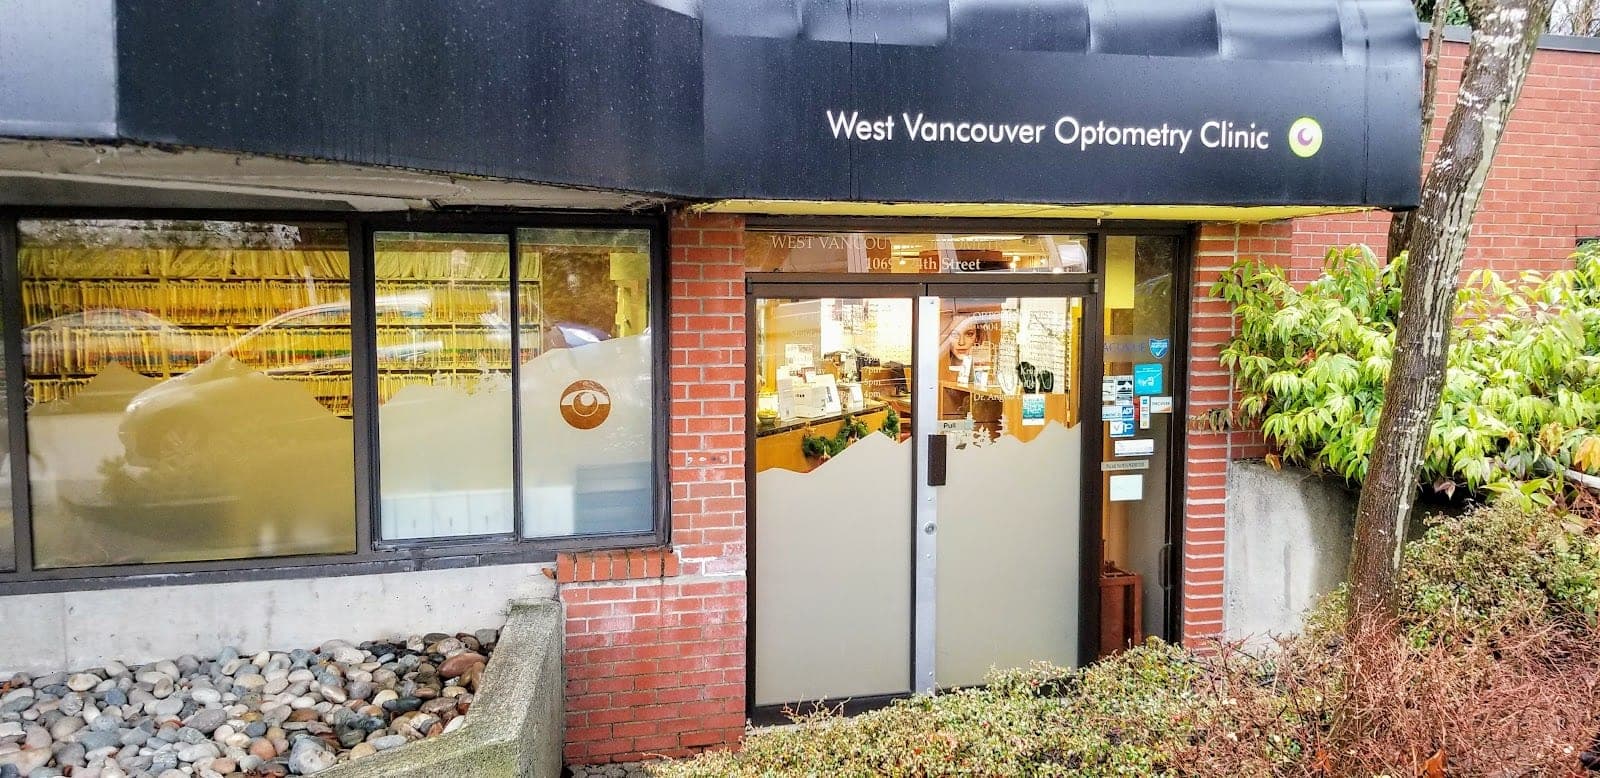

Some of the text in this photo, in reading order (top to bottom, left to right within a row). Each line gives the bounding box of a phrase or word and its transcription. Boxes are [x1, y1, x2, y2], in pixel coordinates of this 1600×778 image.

[826, 110, 1269, 154] West Vancouver Optometry Clinic
[772, 236, 815, 249] WEST
[942, 258, 981, 270] Street
